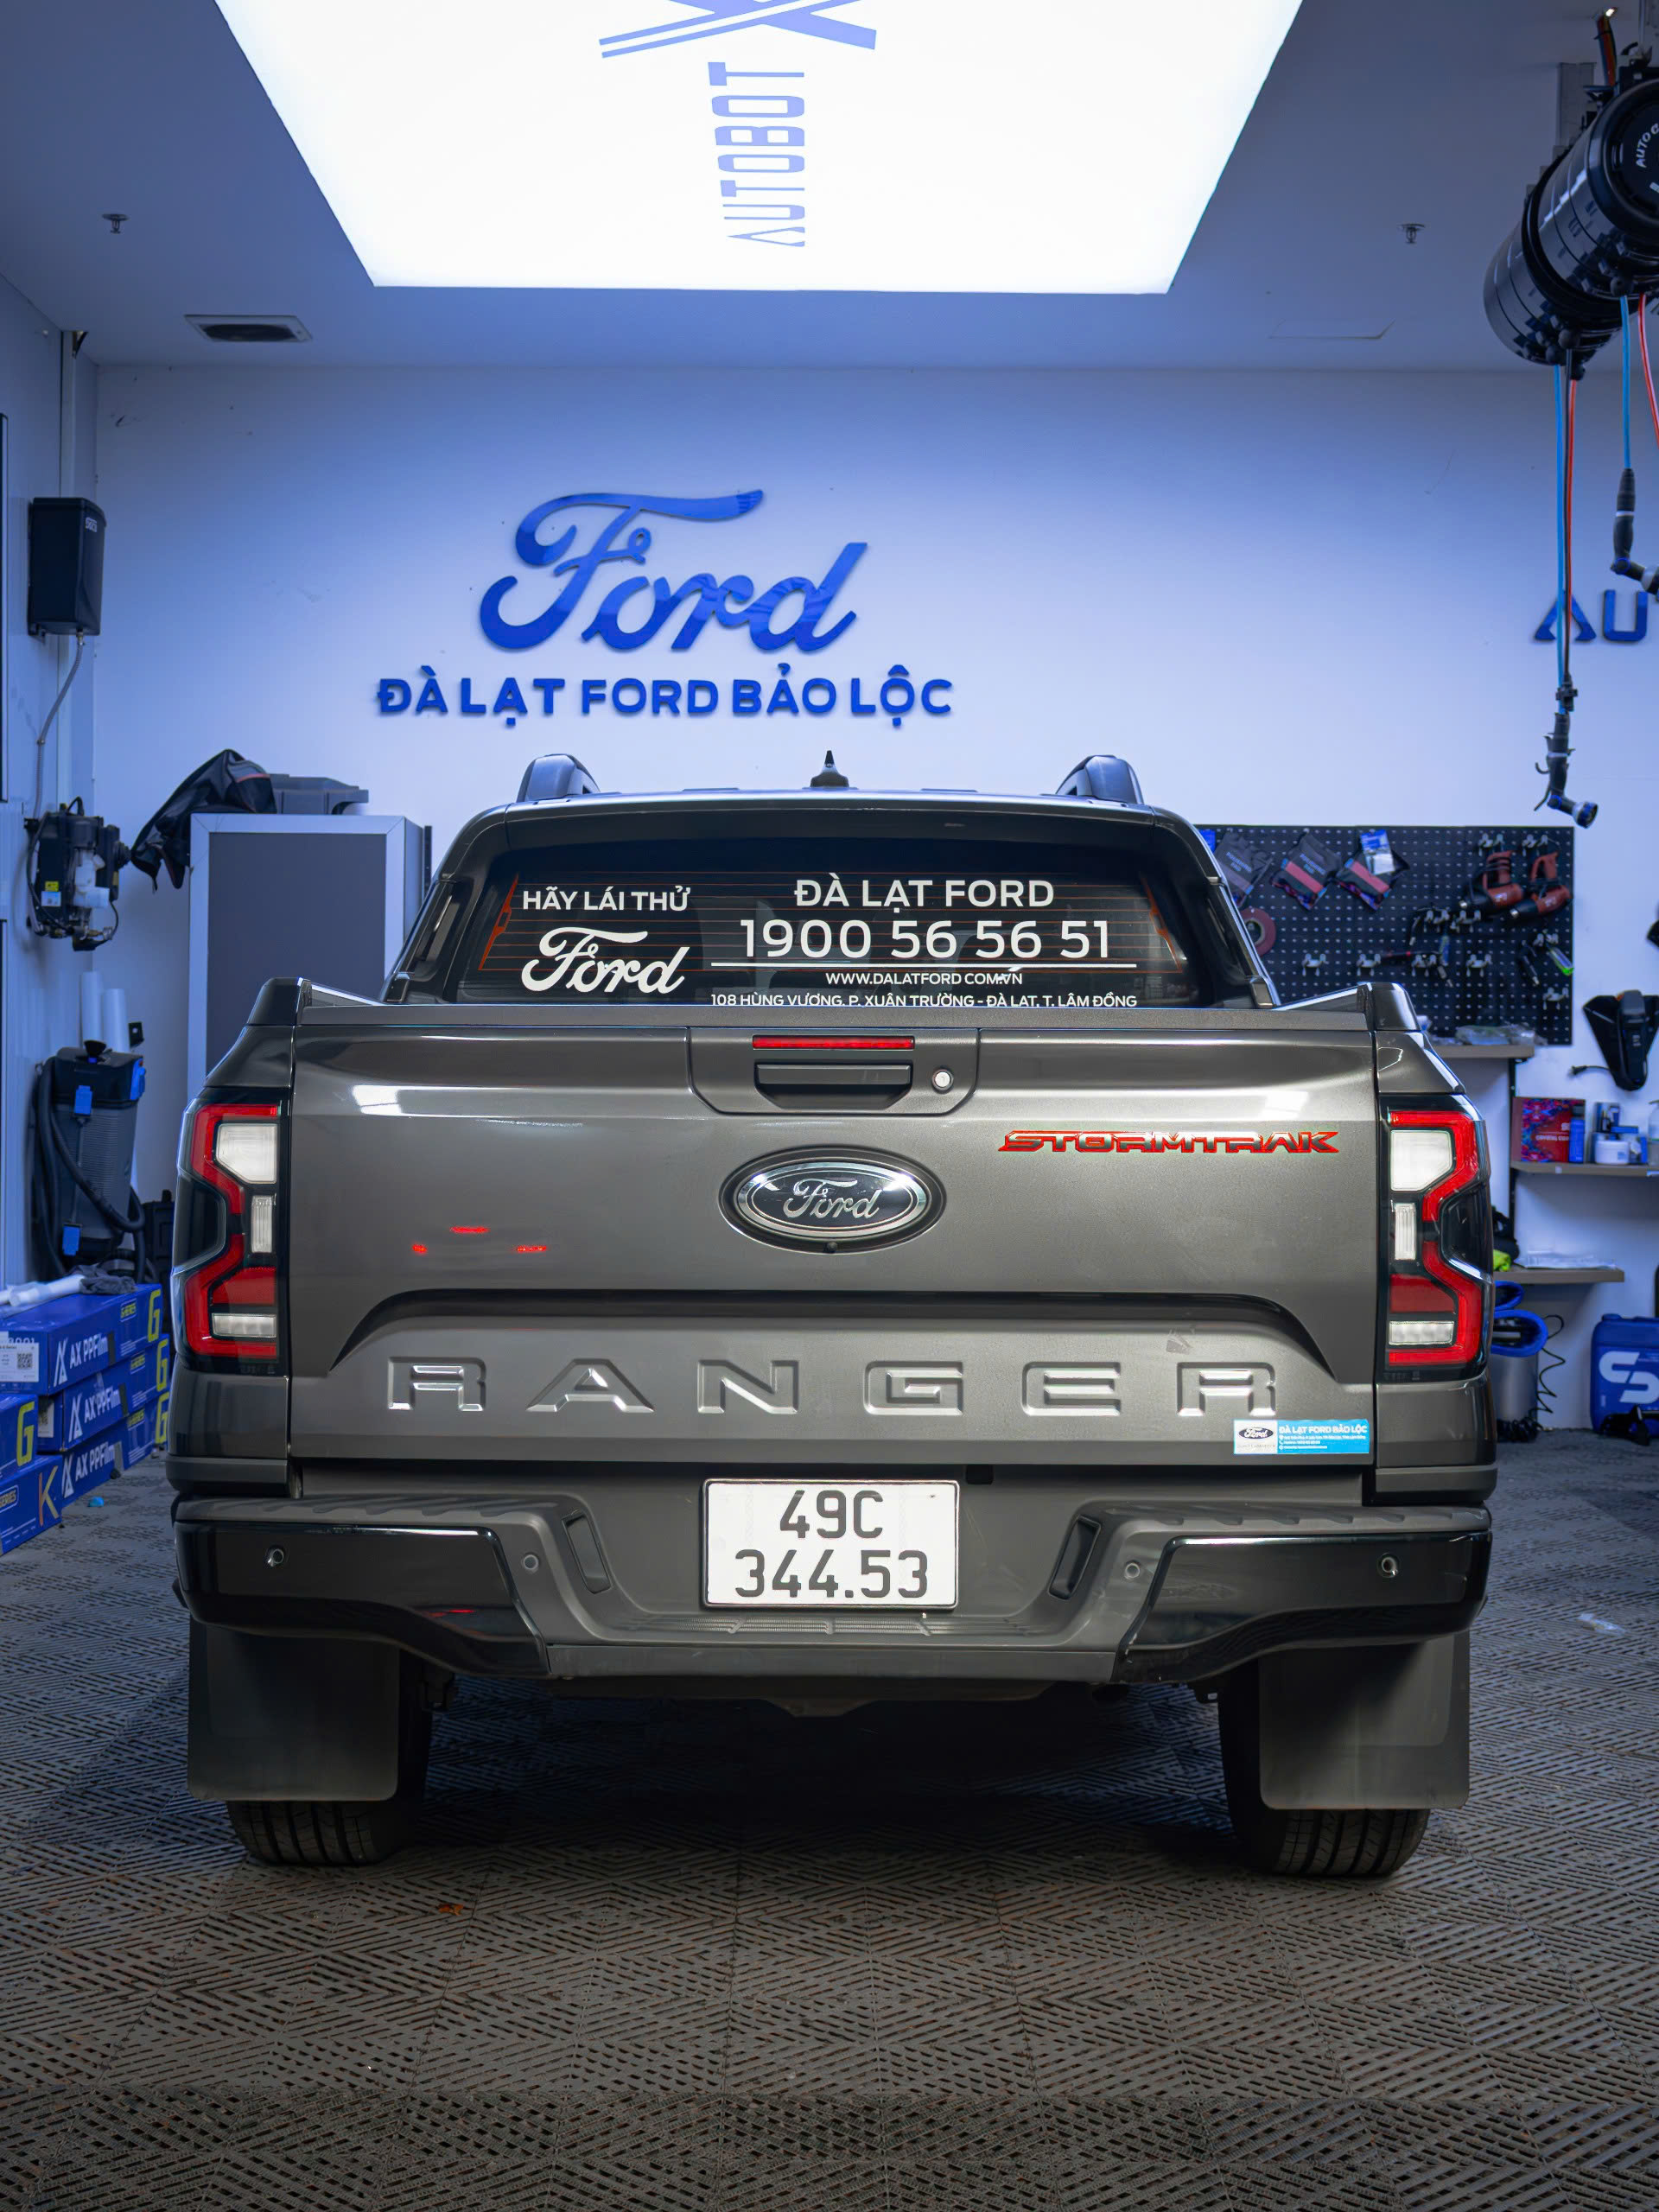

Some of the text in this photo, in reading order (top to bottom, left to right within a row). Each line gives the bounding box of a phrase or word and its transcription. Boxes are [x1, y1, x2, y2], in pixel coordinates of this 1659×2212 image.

[708, 61, 805, 247] AUTOBOT
[480, 489, 868, 652] Ford
[377, 662, 953, 728] ĐÀ LẠT FORD BẢO LỘC
[523, 885, 690, 912] HÃY LÁI THỬ
[794, 873, 1054, 913] ĐÀ LẠT FORD
[521, 926, 690, 995] Ford
[740, 919, 1109, 959] 1900 56 56 51
[710, 994, 736, 1006] 108
[741, 991, 785, 1007] HÙNG
[849, 995, 861, 1007] P.
[864, 992, 906, 1007] XUÂN
[909, 992, 975, 1007] TRƯỜNG
[986, 992, 1007, 1007] ĐÀ
[1042, 995, 1055, 1007] T.
[1058, 992, 1090, 1008] LÂM
[1092, 991, 1137, 1008] ĐỒNG
[998, 1129, 1339, 1154] STORMTRAK
[782, 1178, 883, 1219] Ford
[147, 1288, 162, 1344] G
[156, 1338, 169, 1392] G
[388, 1357, 1276, 1417] RANGER
[16, 1401, 35, 1467] G
[38, 1465, 60, 1528] K
[779, 1490, 884, 1539] 49C
[734, 1548, 928, 1599] 344.53
